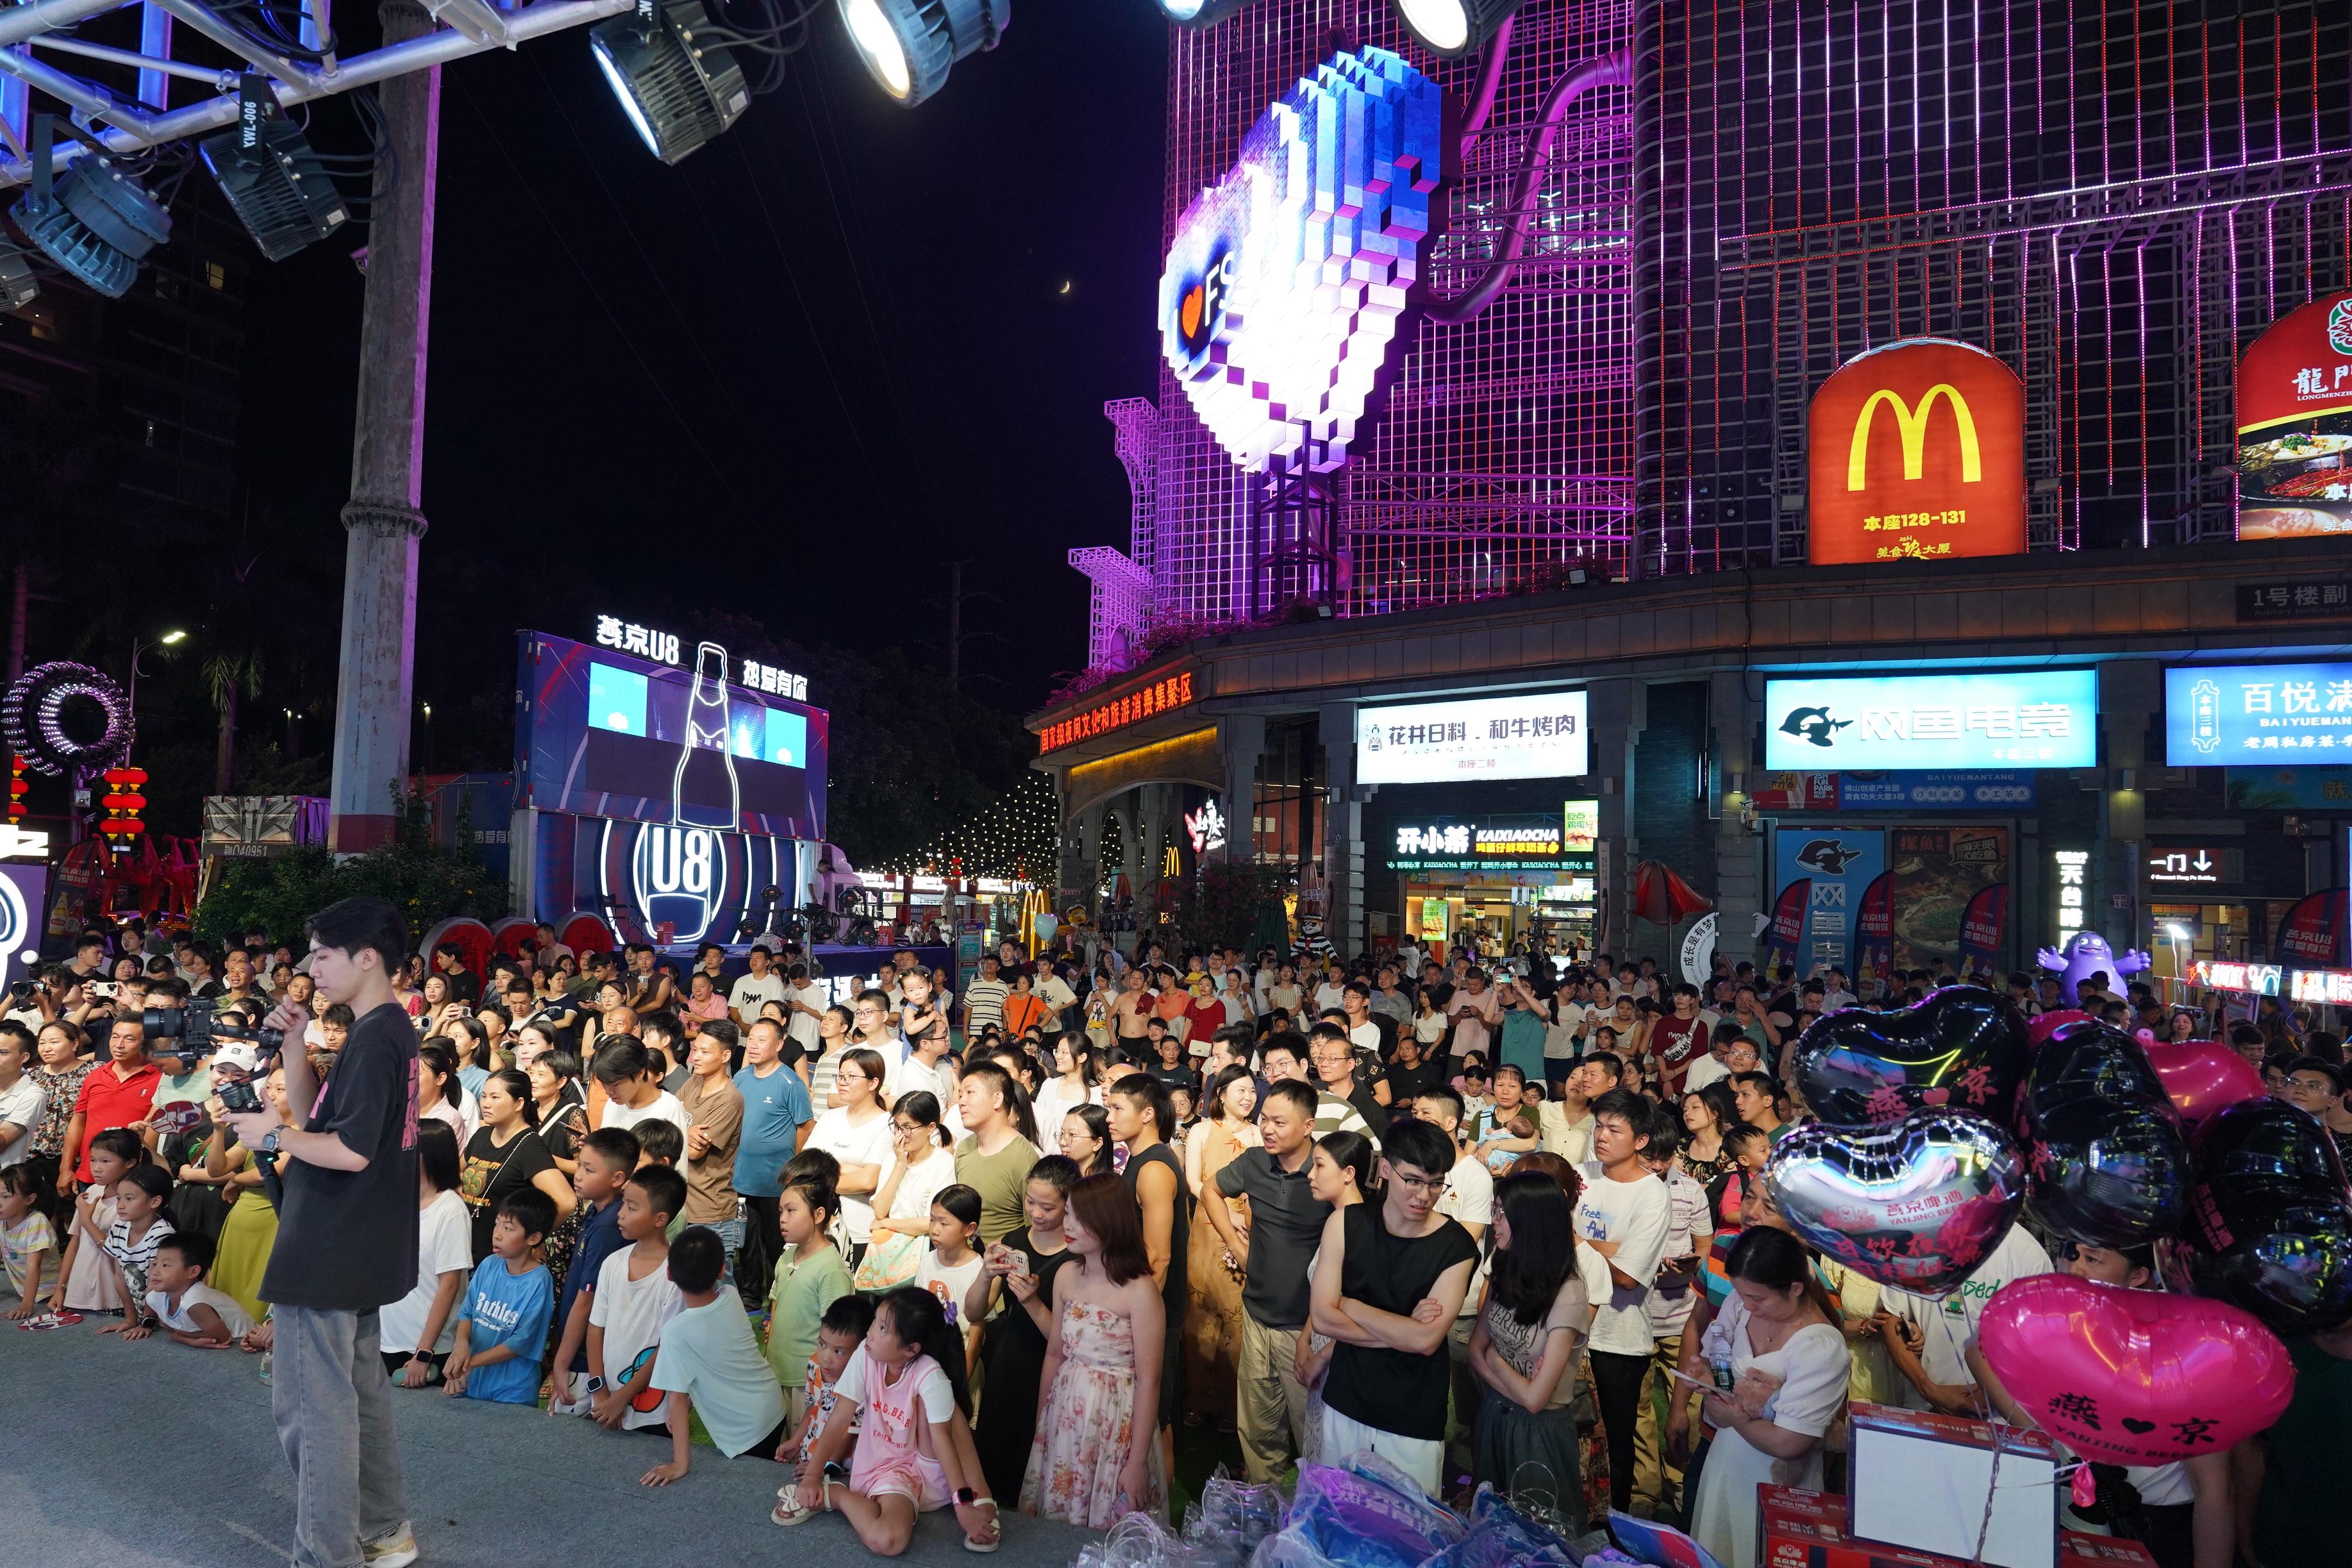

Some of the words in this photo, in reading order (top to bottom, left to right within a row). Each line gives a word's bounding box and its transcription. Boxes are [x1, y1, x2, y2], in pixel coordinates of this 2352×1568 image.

[1864, 510, 1966, 531] 本座128-131
[2254, 585, 2348, 607] 1号楼副
[596, 614, 680, 665] 燕京U8
[743, 660, 808, 701] 热爱有你
[1041, 672, 1192, 753] 国家级夜间文化和旅游消费集聚区
[1860, 701, 2073, 740] 网鱼电竞
[2199, 694, 2212, 737] 本座三楼
[1458, 759, 1496, 769] 本座二楼
[474, 830, 511, 844] 热爱有
[1476, 829, 1559, 842] KAIXIAOCHA
[651, 829, 710, 892] U8
[1775, 915, 1800, 929] 燕京U8
[1862, 913, 1889, 922] 燕京U8
[1683, 914, 1717, 967] 成长是有梦
[2283, 940, 2330, 956] 热爱有你
[2285, 929, 2332, 945] 燕京U8
[1957, 1069, 1999, 1105] 京
[1885, 1189, 1964, 1217] 燕京啤酒
[1889, 1212, 1935, 1226] YANJING
[2048, 1391, 2101, 1432] 燕
[2170, 1417, 2221, 1446] 京
[2055, 1423, 2139, 1457] YANJING
